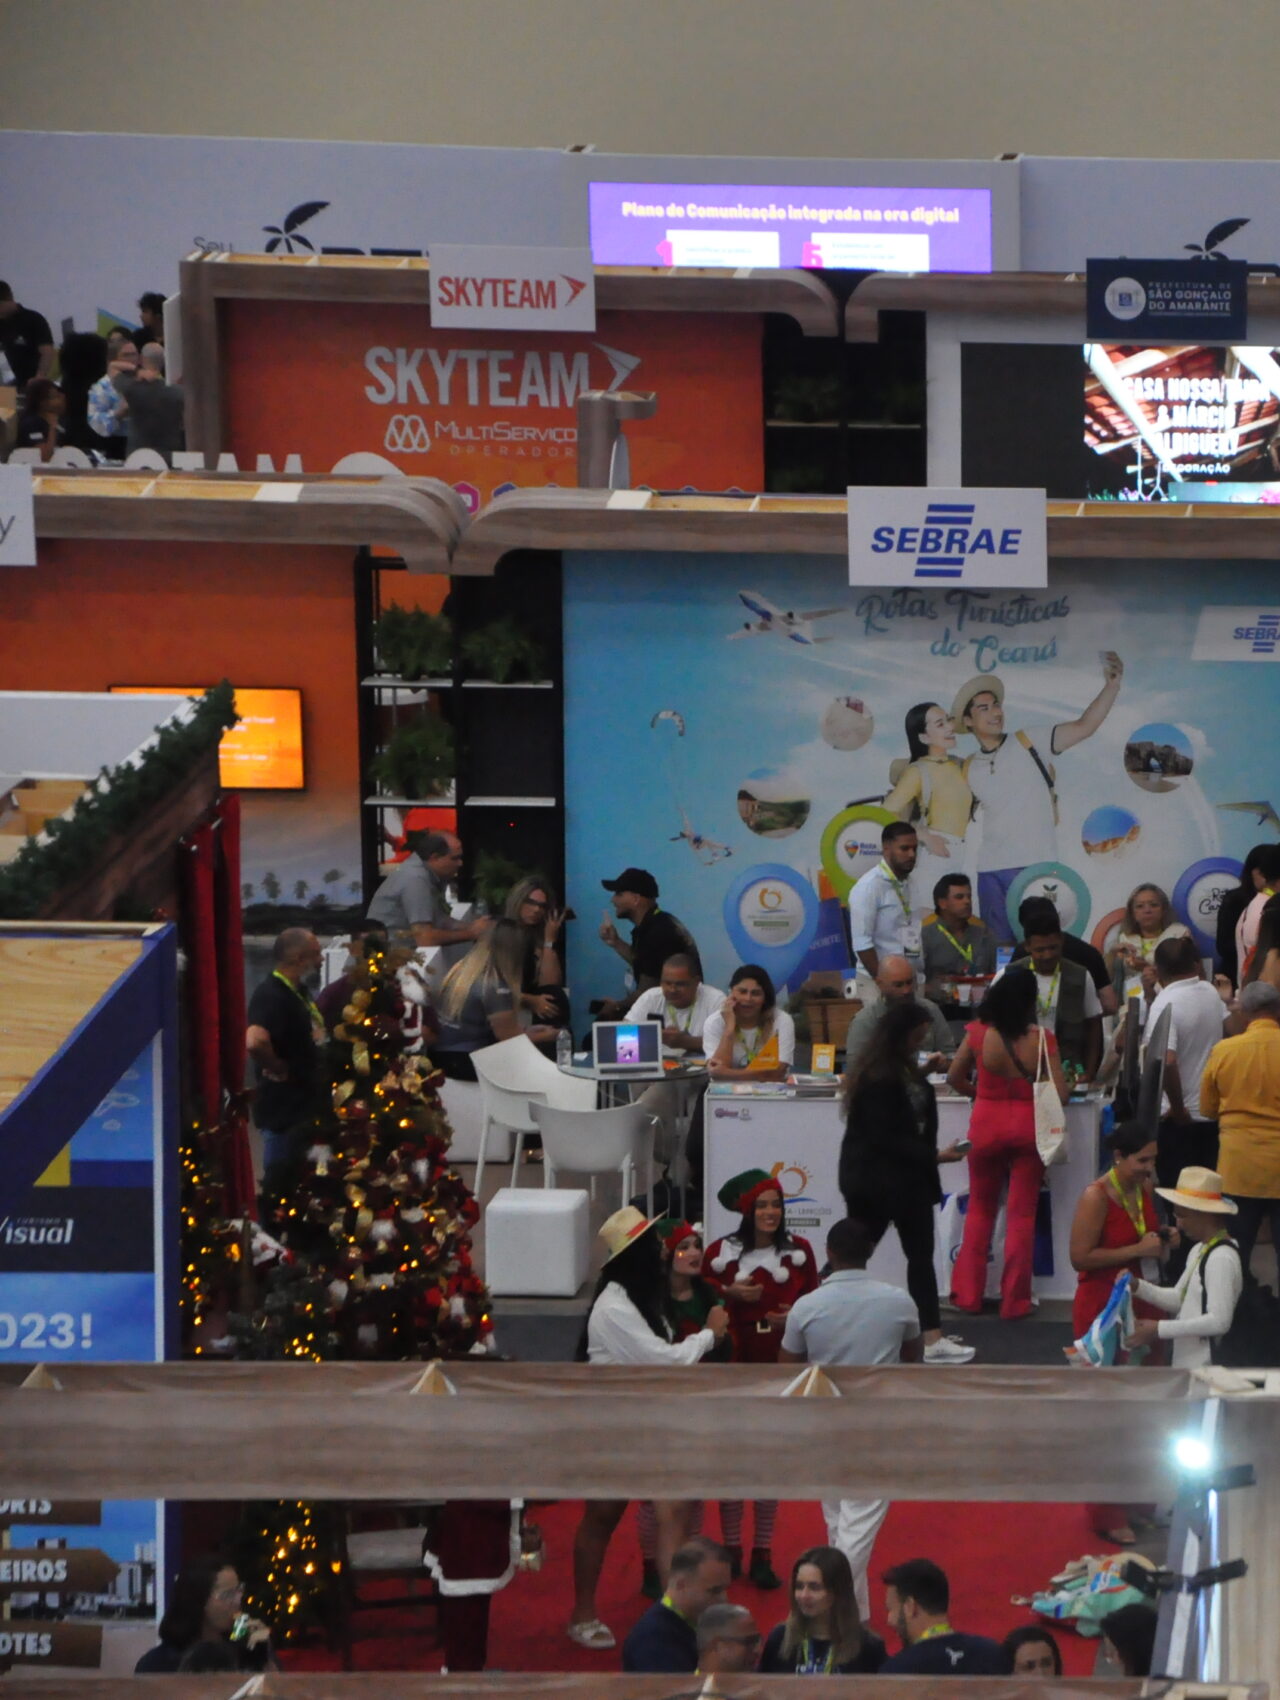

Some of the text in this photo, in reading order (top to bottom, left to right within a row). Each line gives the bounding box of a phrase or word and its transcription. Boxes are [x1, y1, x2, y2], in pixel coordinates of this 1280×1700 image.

[621, 201, 959, 225] Plano de Comunicação integrada na era digital
[437, 276, 557, 309] SKYTEAM
[1148, 288, 1232, 302] SÃO GONÇALO
[1148, 301, 1231, 312] DO AMARANTE
[364, 346, 590, 408] SKYTEAM
[871, 526, 1022, 555] SEBRAE
[856, 587, 938, 636] Rotas
[969, 635, 1057, 673] Ceará
[0, 1559, 67, 1582] EIROS
[0, 1632, 51, 1656] OTES
